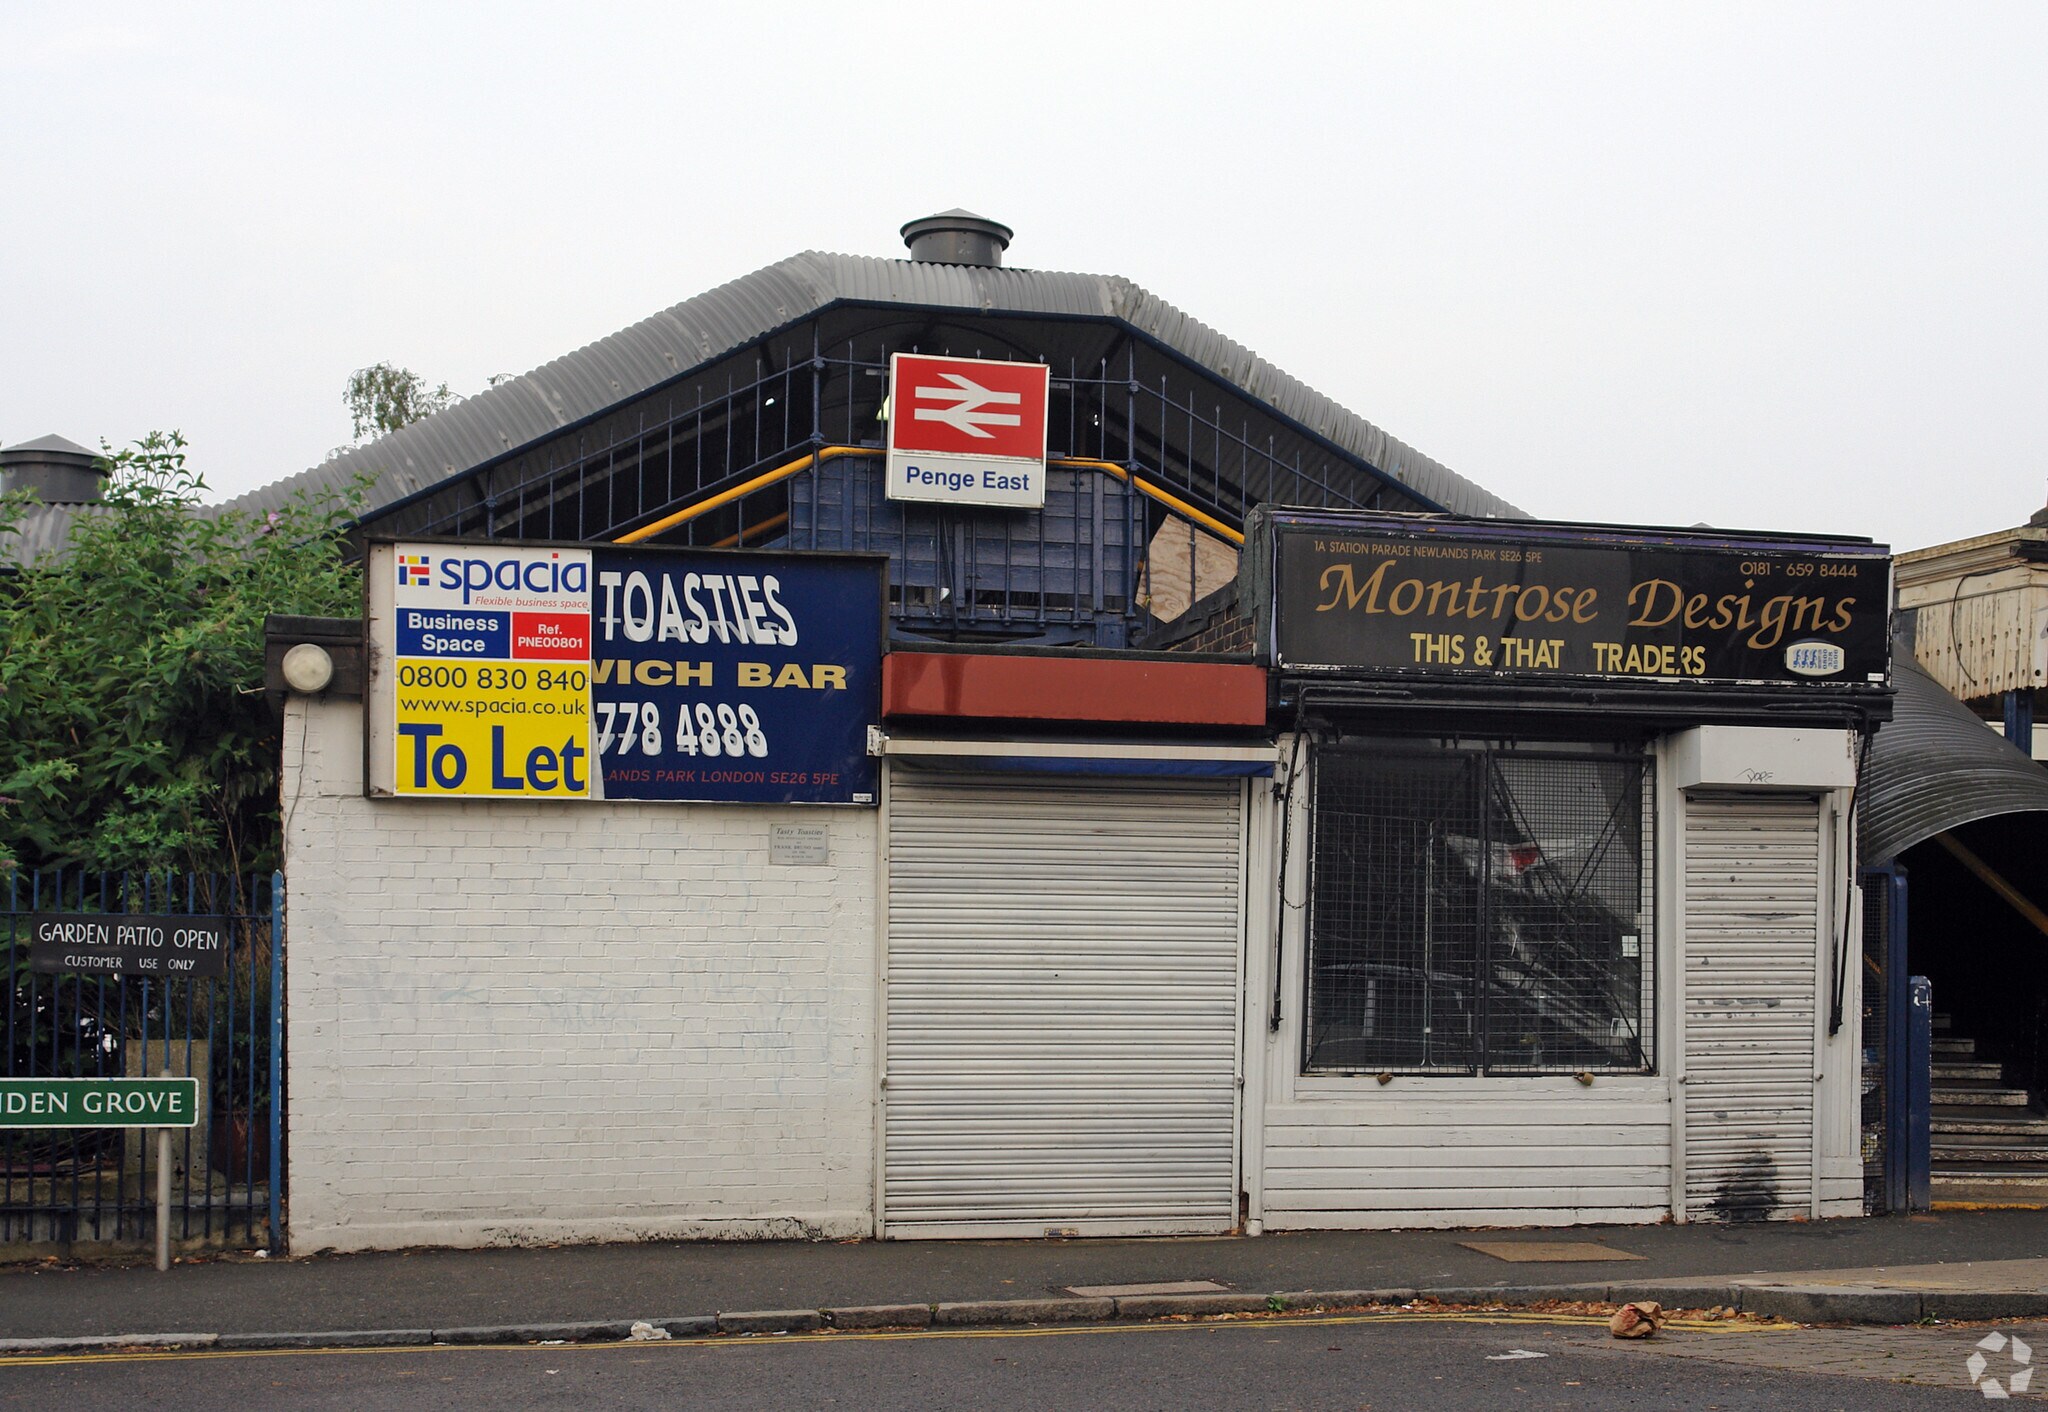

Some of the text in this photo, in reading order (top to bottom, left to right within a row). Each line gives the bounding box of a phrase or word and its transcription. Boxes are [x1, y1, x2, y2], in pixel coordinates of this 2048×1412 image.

[906, 466, 1029, 491] Penge East
[1314, 540, 1542, 563] 1A STATION PARADE NEWLANDS PARK SE26 5PE
[439, 553, 587, 605] spacia
[1786, 563, 1814, 577] 659
[1820, 564, 1858, 578] 8444
[475, 596, 588, 610] Flexible business space
[600, 571, 798, 646] TOASTIES
[1316, 560, 1857, 649] Montrose Designs
[408, 612, 499, 632] Business
[538, 624, 562, 635] Ref.
[422, 634, 486, 654] Space
[518, 637, 583, 648] PNE00801
[1410, 632, 1706, 675] THIS & THAT TRADERS
[400, 666, 586, 691] 0800 830 840
[738, 662, 847, 690] BAR
[400, 698, 586, 718] www.spacia.co.uk
[597, 701, 768, 758] 778 4888
[398, 722, 585, 792] To Let
[604, 770, 839, 786] ANDS PARK LONDON SE26 5PE
[776, 828, 823, 836] Tasty Toasties
[39, 922, 218, 950] GARDEN PATIO OPEN
[64, 955, 195, 971] CUSTOMER USE ONLY
[0, 1091, 183, 1114] DEN GROVE
